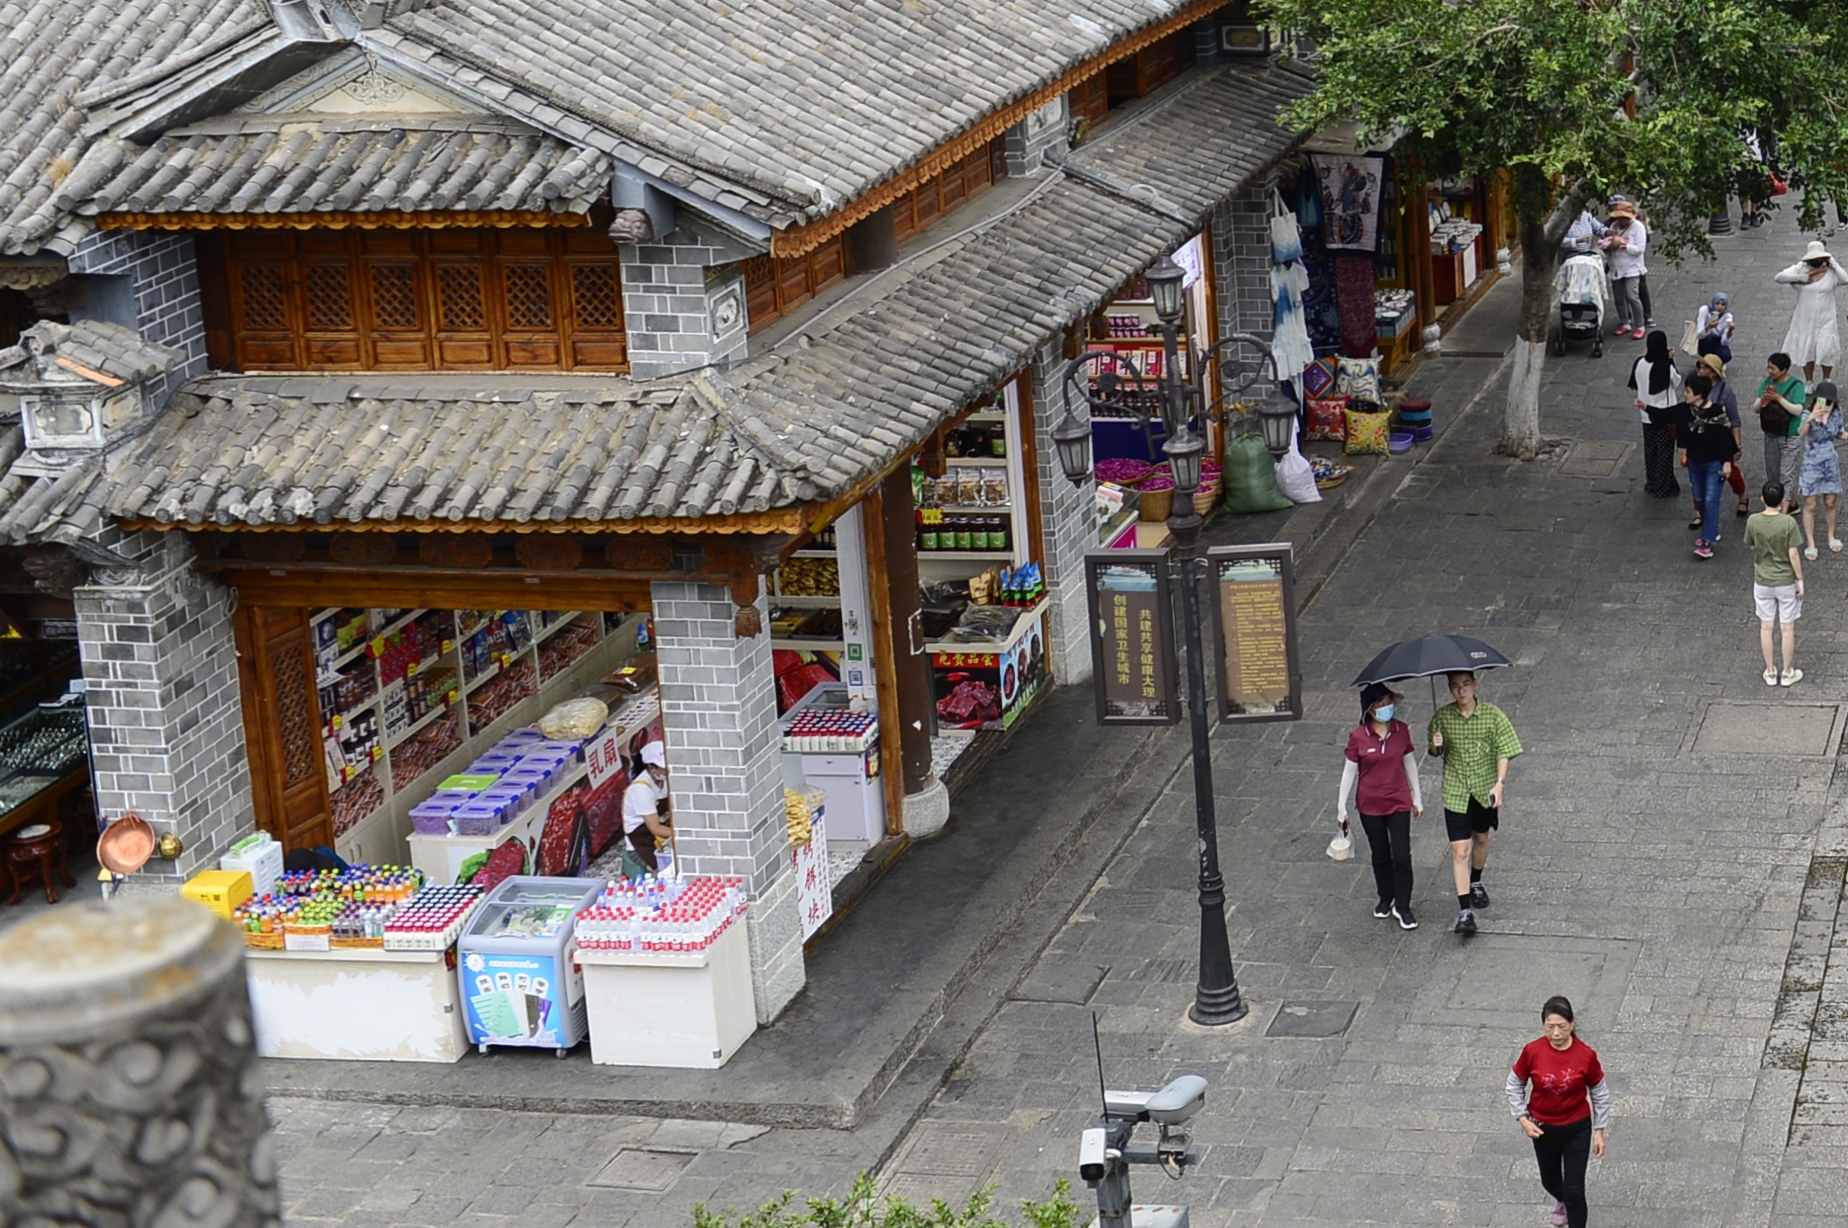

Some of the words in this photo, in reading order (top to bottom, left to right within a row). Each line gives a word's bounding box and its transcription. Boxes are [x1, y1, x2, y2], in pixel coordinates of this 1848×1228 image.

[1113, 594, 1130, 685] 创建国家卫生城市
[1139, 609, 1156, 698] 共建共享健康大理
[588, 737, 618, 780] 乳扇
